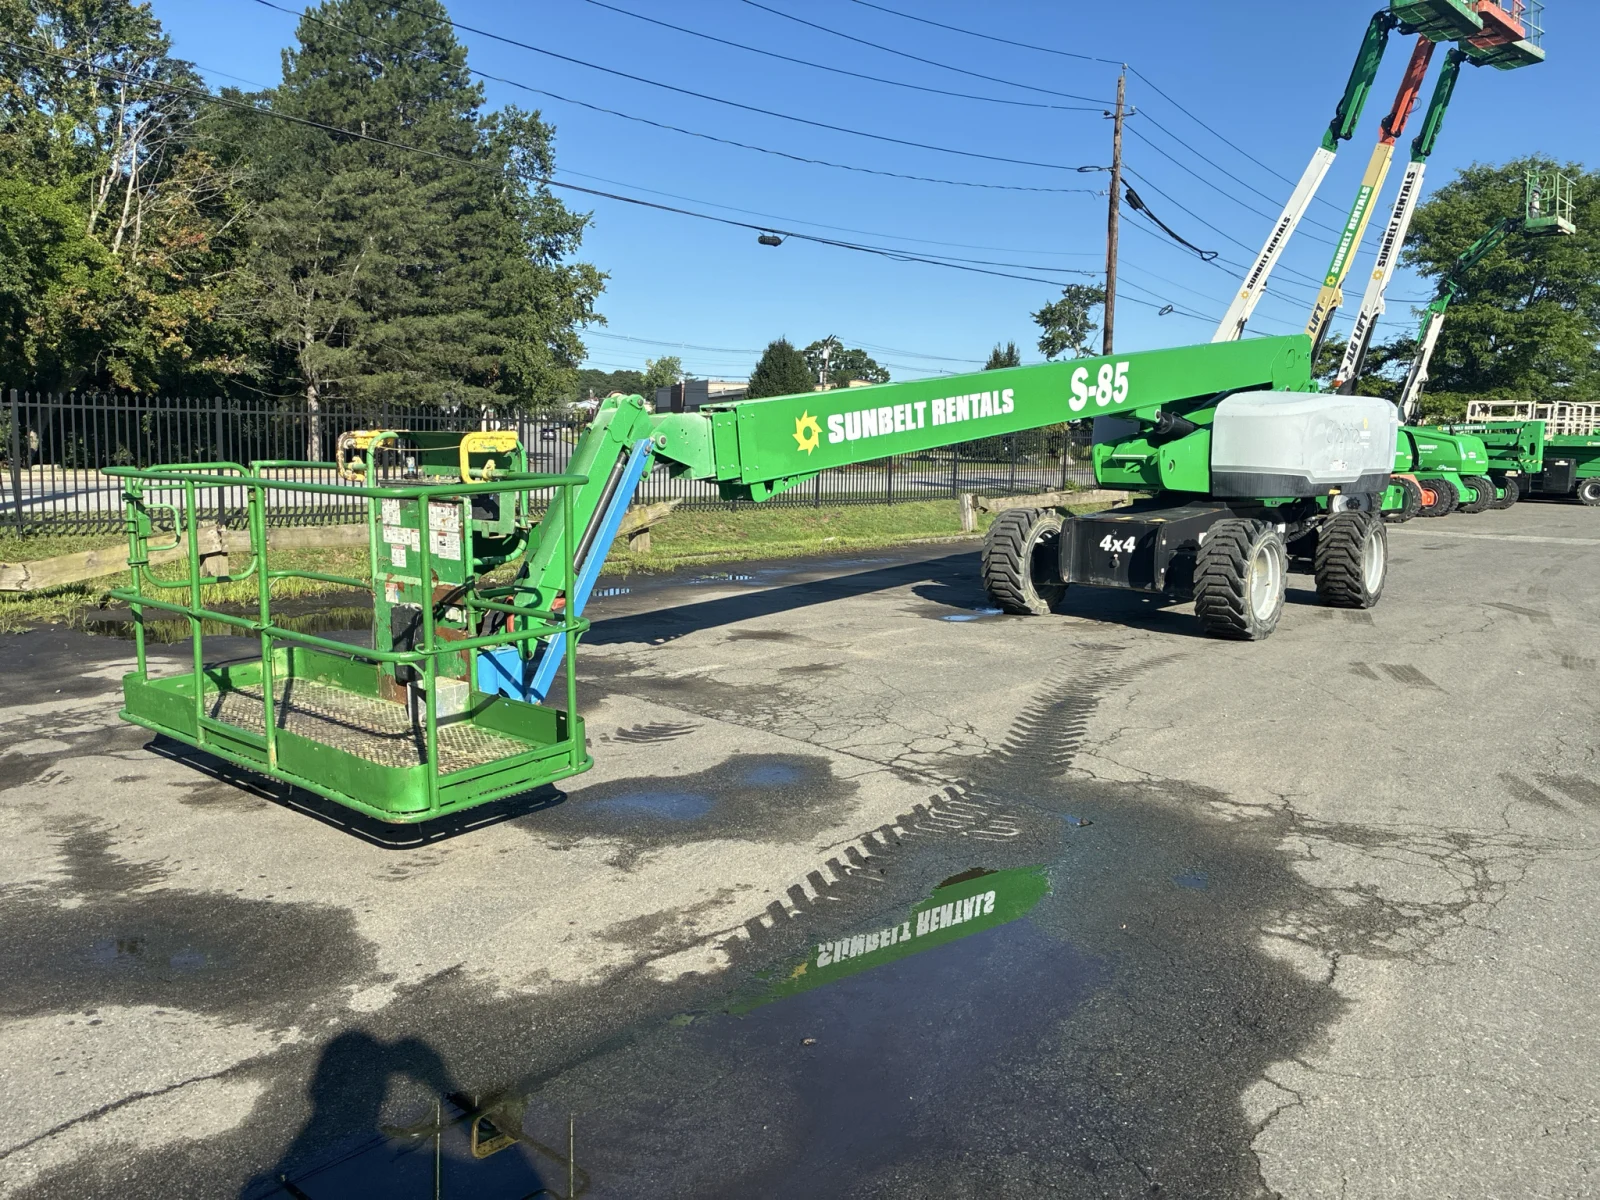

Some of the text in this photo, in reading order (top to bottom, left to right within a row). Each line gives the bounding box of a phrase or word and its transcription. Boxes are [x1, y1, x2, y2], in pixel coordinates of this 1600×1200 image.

[1331, 186, 1370, 274] SUNBELT RENTALS
[1377, 171, 1416, 267] SUNBELT RENTALS
[1246, 216, 1291, 290] SUNBELT RENTALS
[1308, 303, 1324, 334] LIFT
[1346, 341, 1359, 366] JLG
[1353, 311, 1368, 341] LIFT
[1068, 361, 1130, 412] S-85
[827, 388, 1015, 444] SUNBELT RENTALS
[1099, 534, 1136, 553] 4x4
